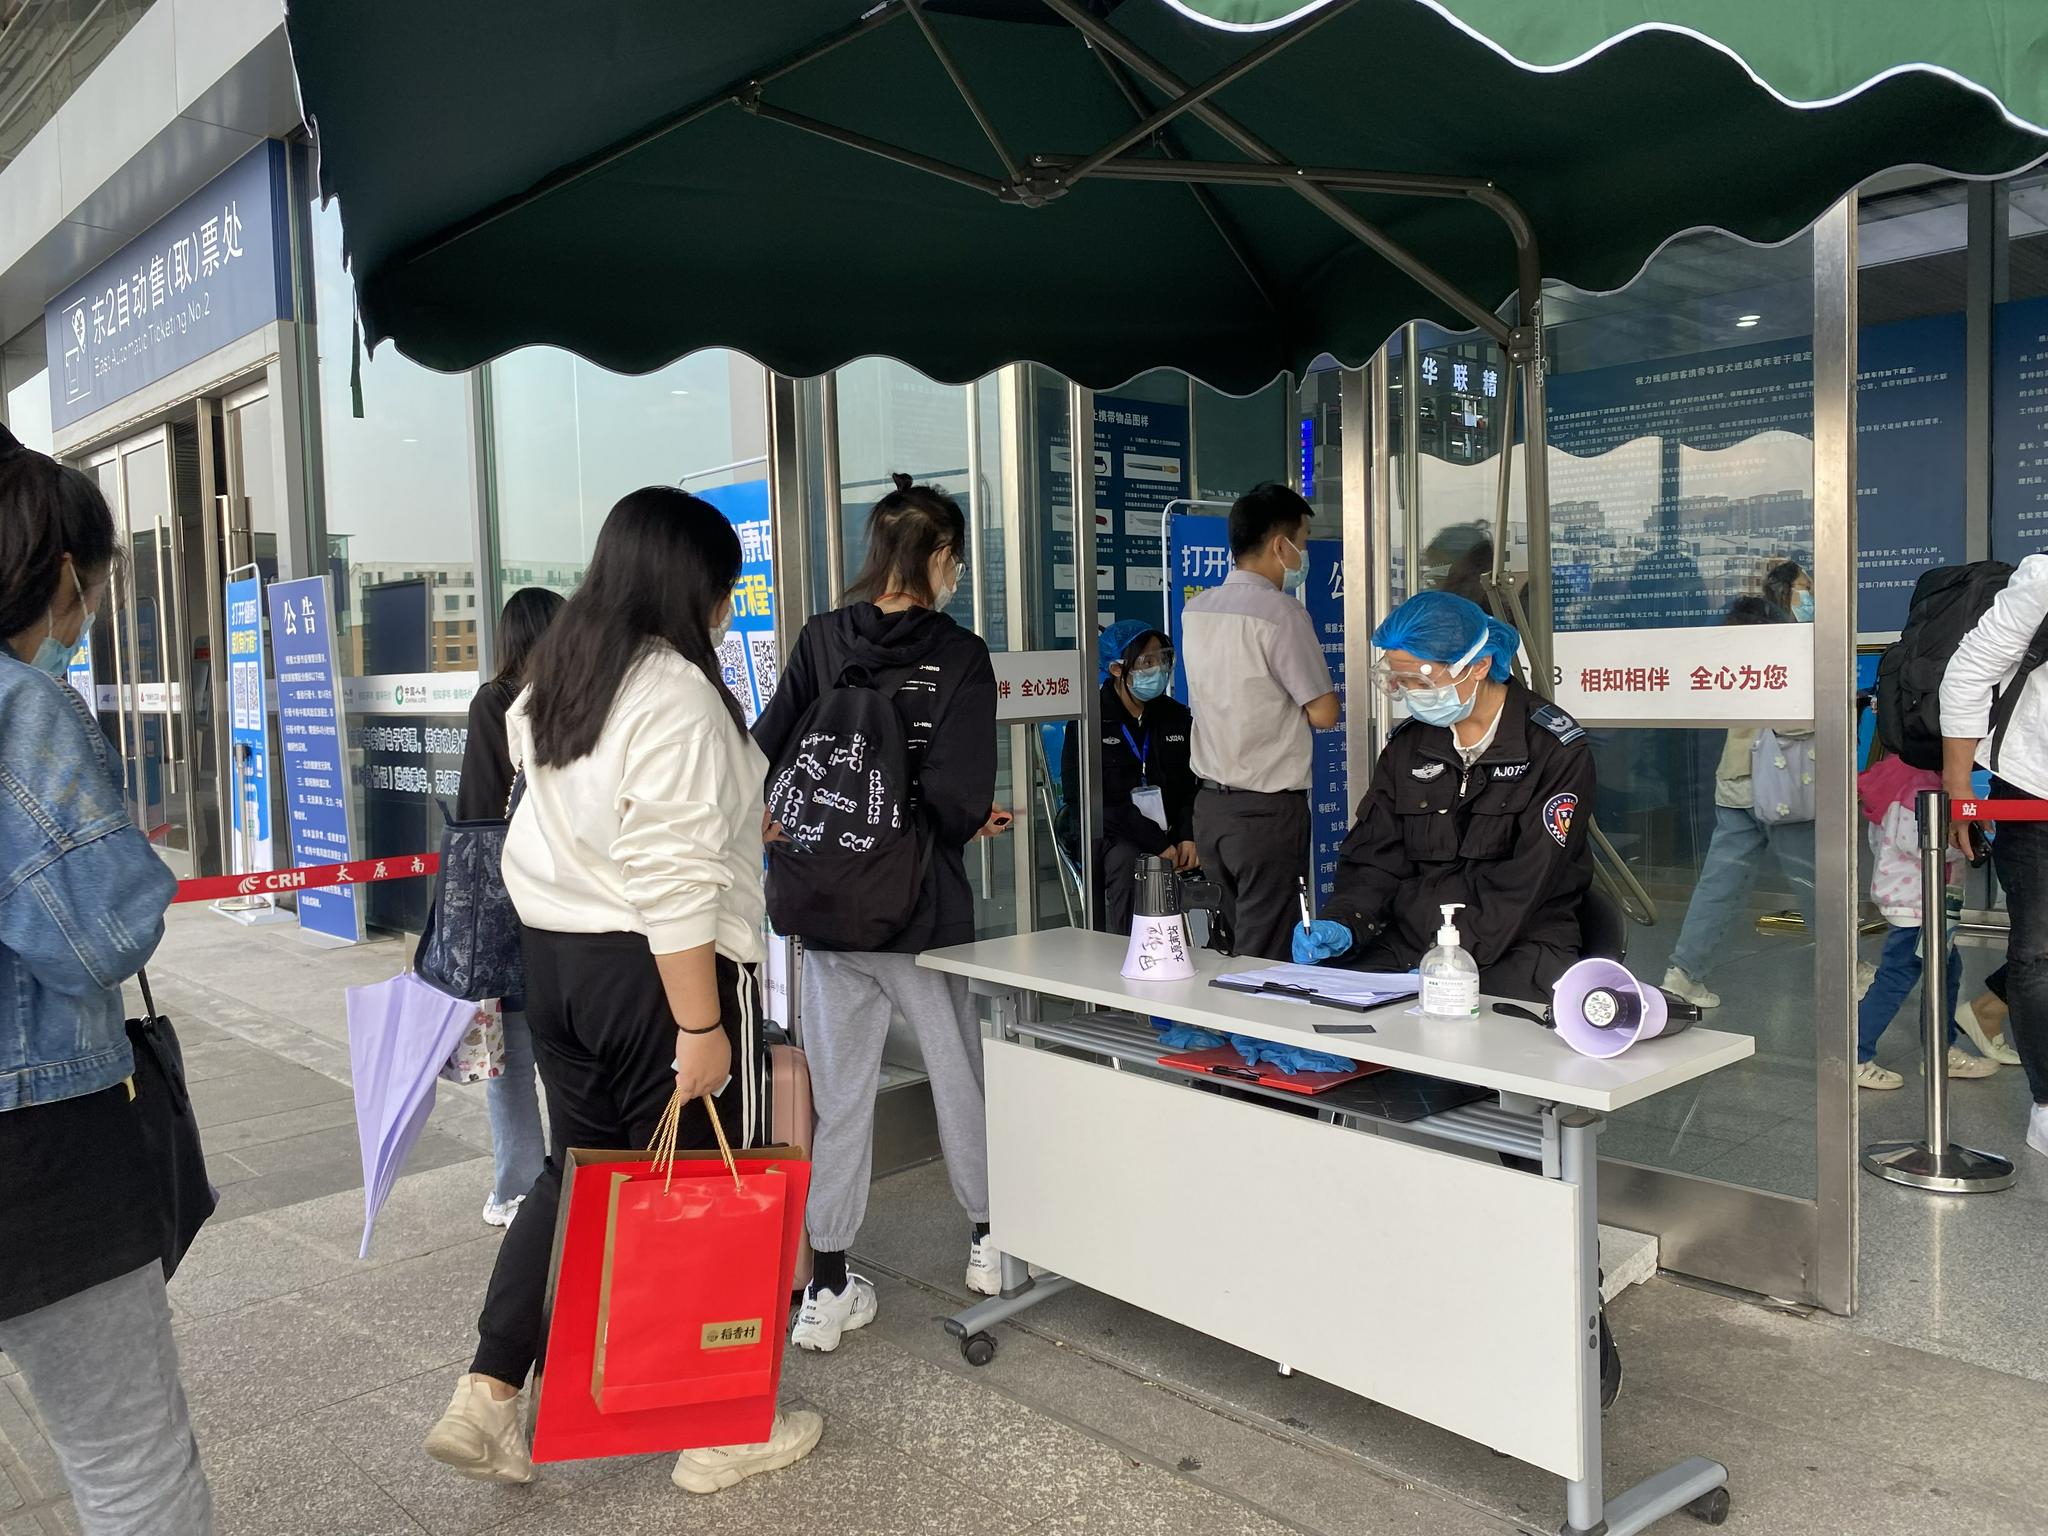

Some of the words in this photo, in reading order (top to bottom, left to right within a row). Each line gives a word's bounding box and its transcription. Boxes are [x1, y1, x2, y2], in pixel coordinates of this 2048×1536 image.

[91, 200, 243, 345] 东2自动售(取)票处
[94, 353, 111, 377] East
[111, 334, 148, 367] Automatic
[148, 311, 187, 346] Ticketing
[188, 292, 211, 325] No.2
[283, 595, 316, 636] 公告
[1021, 677, 1070, 697] 全心为您
[1579, 666, 1671, 693] 相知相伴
[1689, 664, 1789, 691] 全心为您
[866, 769, 886, 825] adidas
[1962, 802, 1977, 816] 站
[265, 871, 306, 890] CRH
[336, 856, 425, 882] 太原南
[720, 1325, 755, 1341] 稻香村
